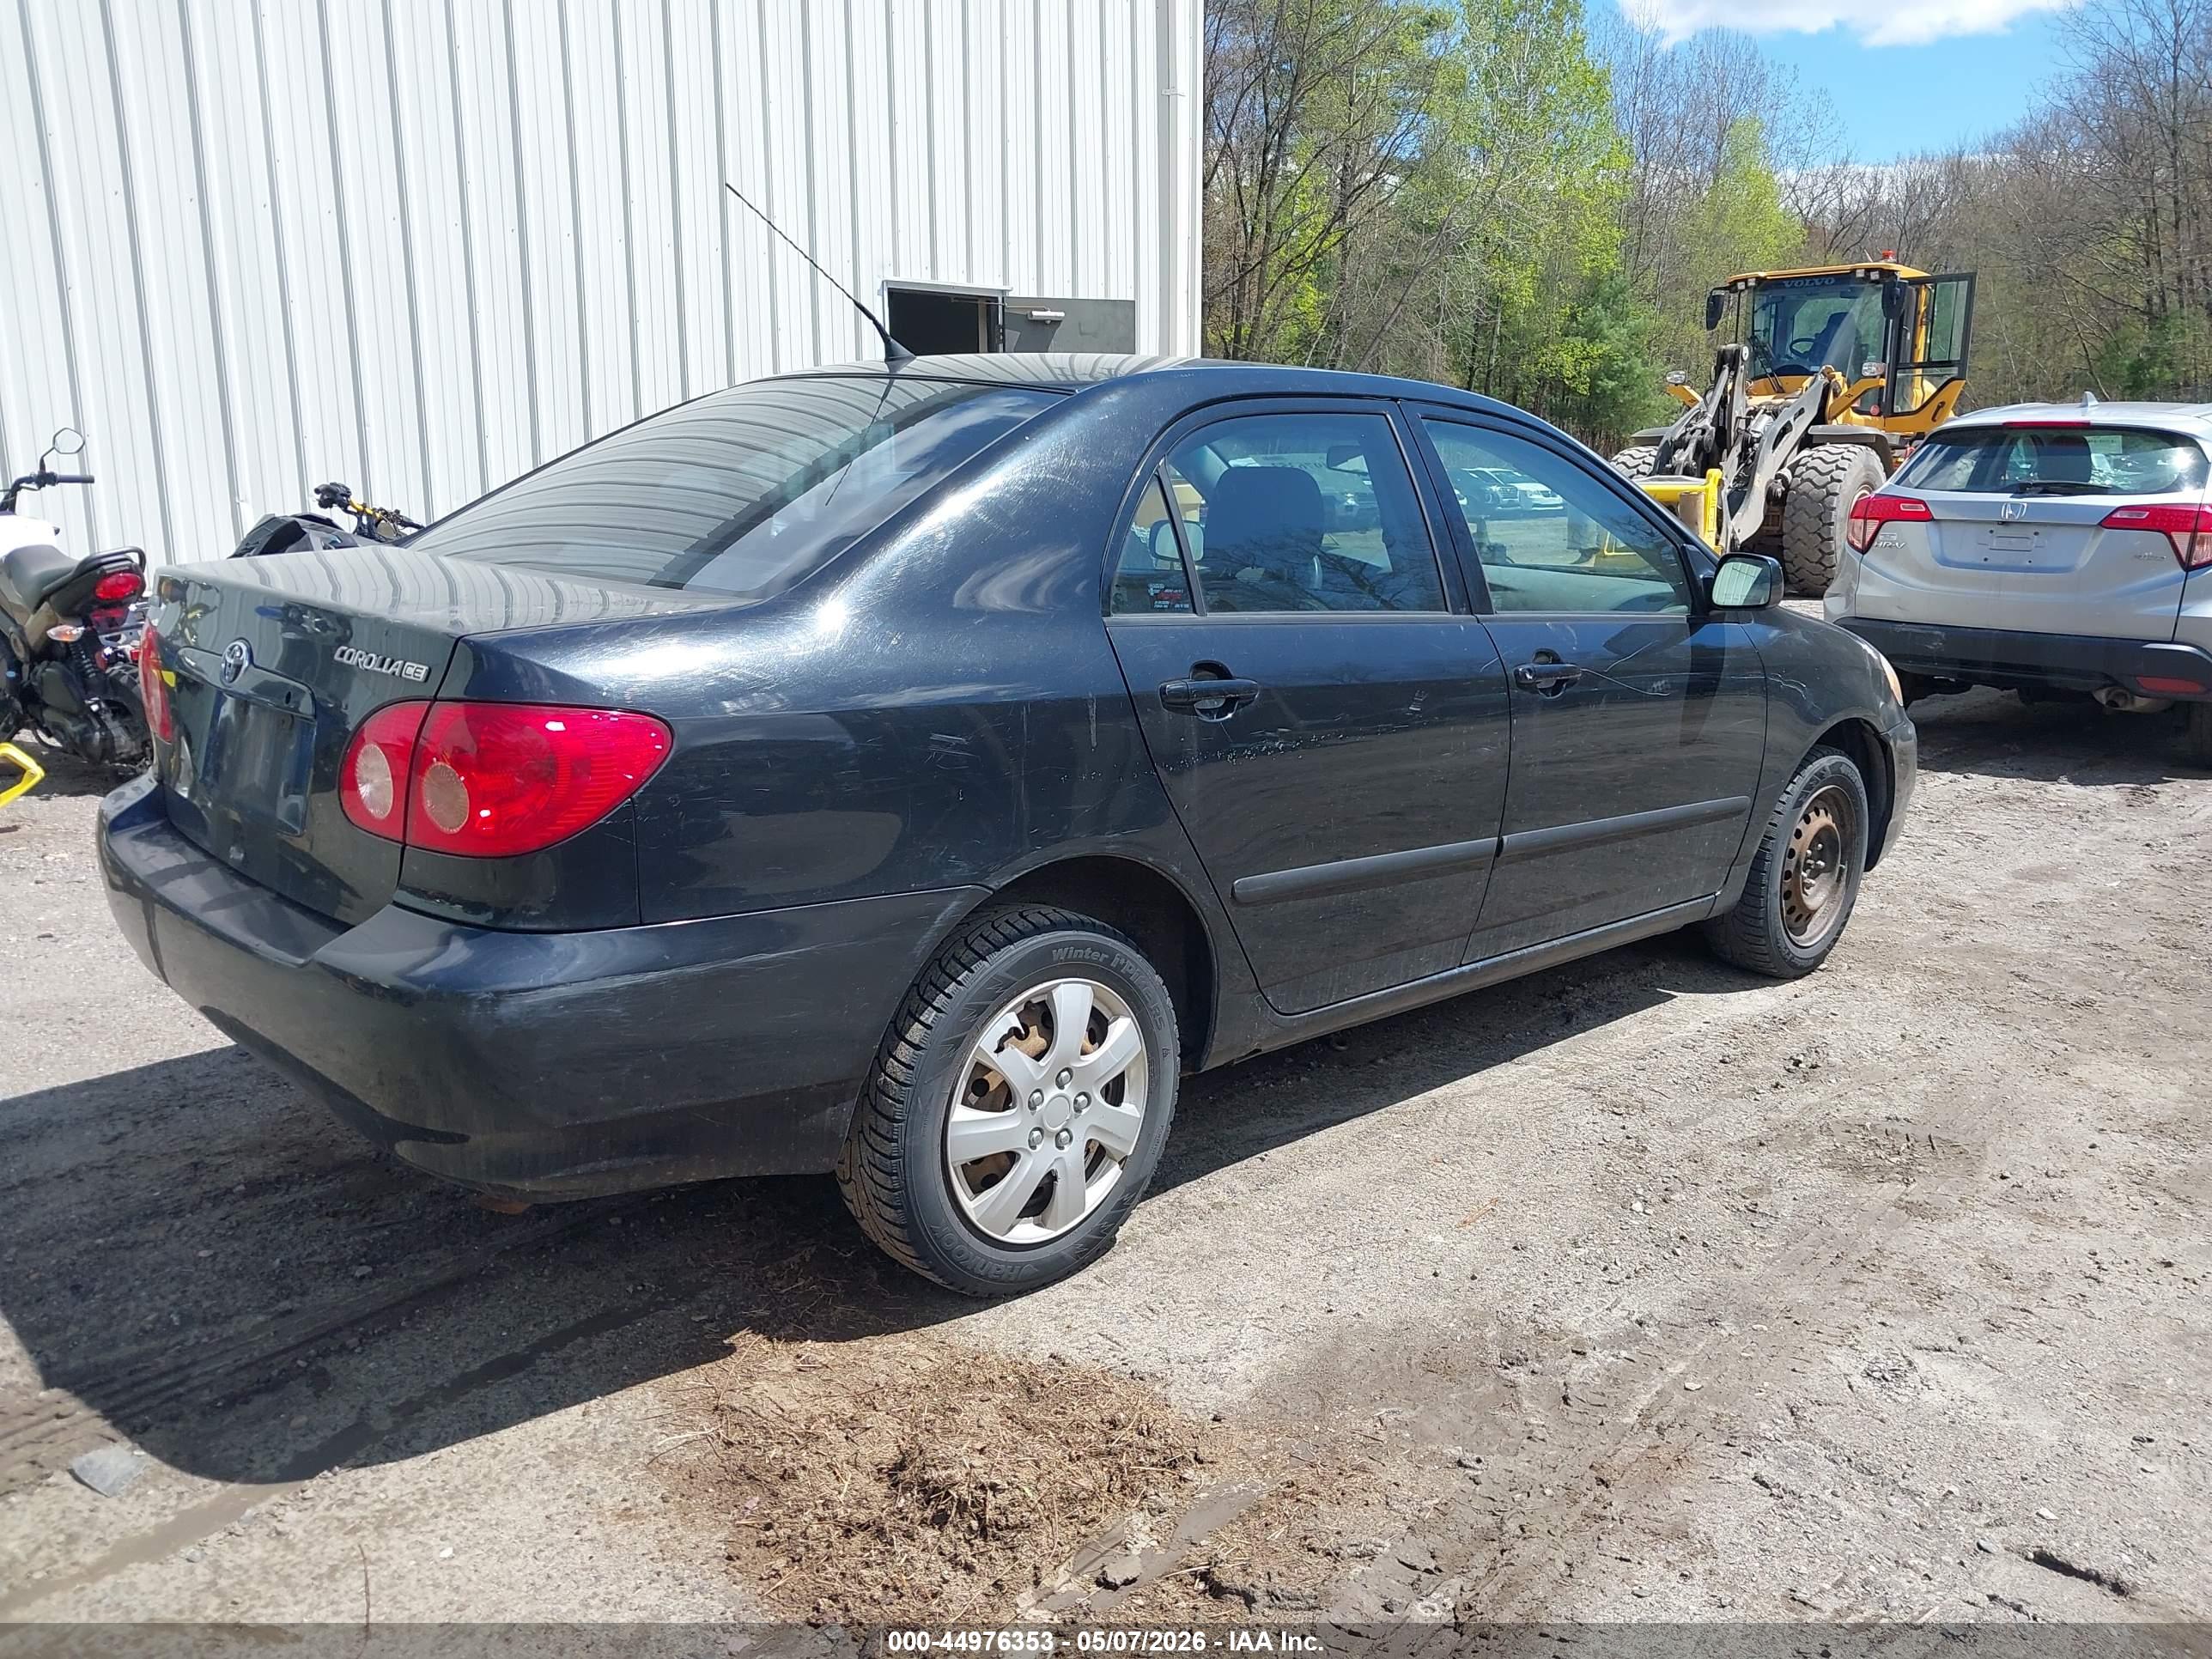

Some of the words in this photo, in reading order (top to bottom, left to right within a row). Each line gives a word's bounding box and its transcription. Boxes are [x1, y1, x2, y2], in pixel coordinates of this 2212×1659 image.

[1784, 277, 1835, 288] VOLVO
[1874, 541, 1906, 550] HR-V
[333, 646, 404, 677] COROLLA
[403, 663, 427, 681] CE
[1052, 946, 1109, 963] Winter
